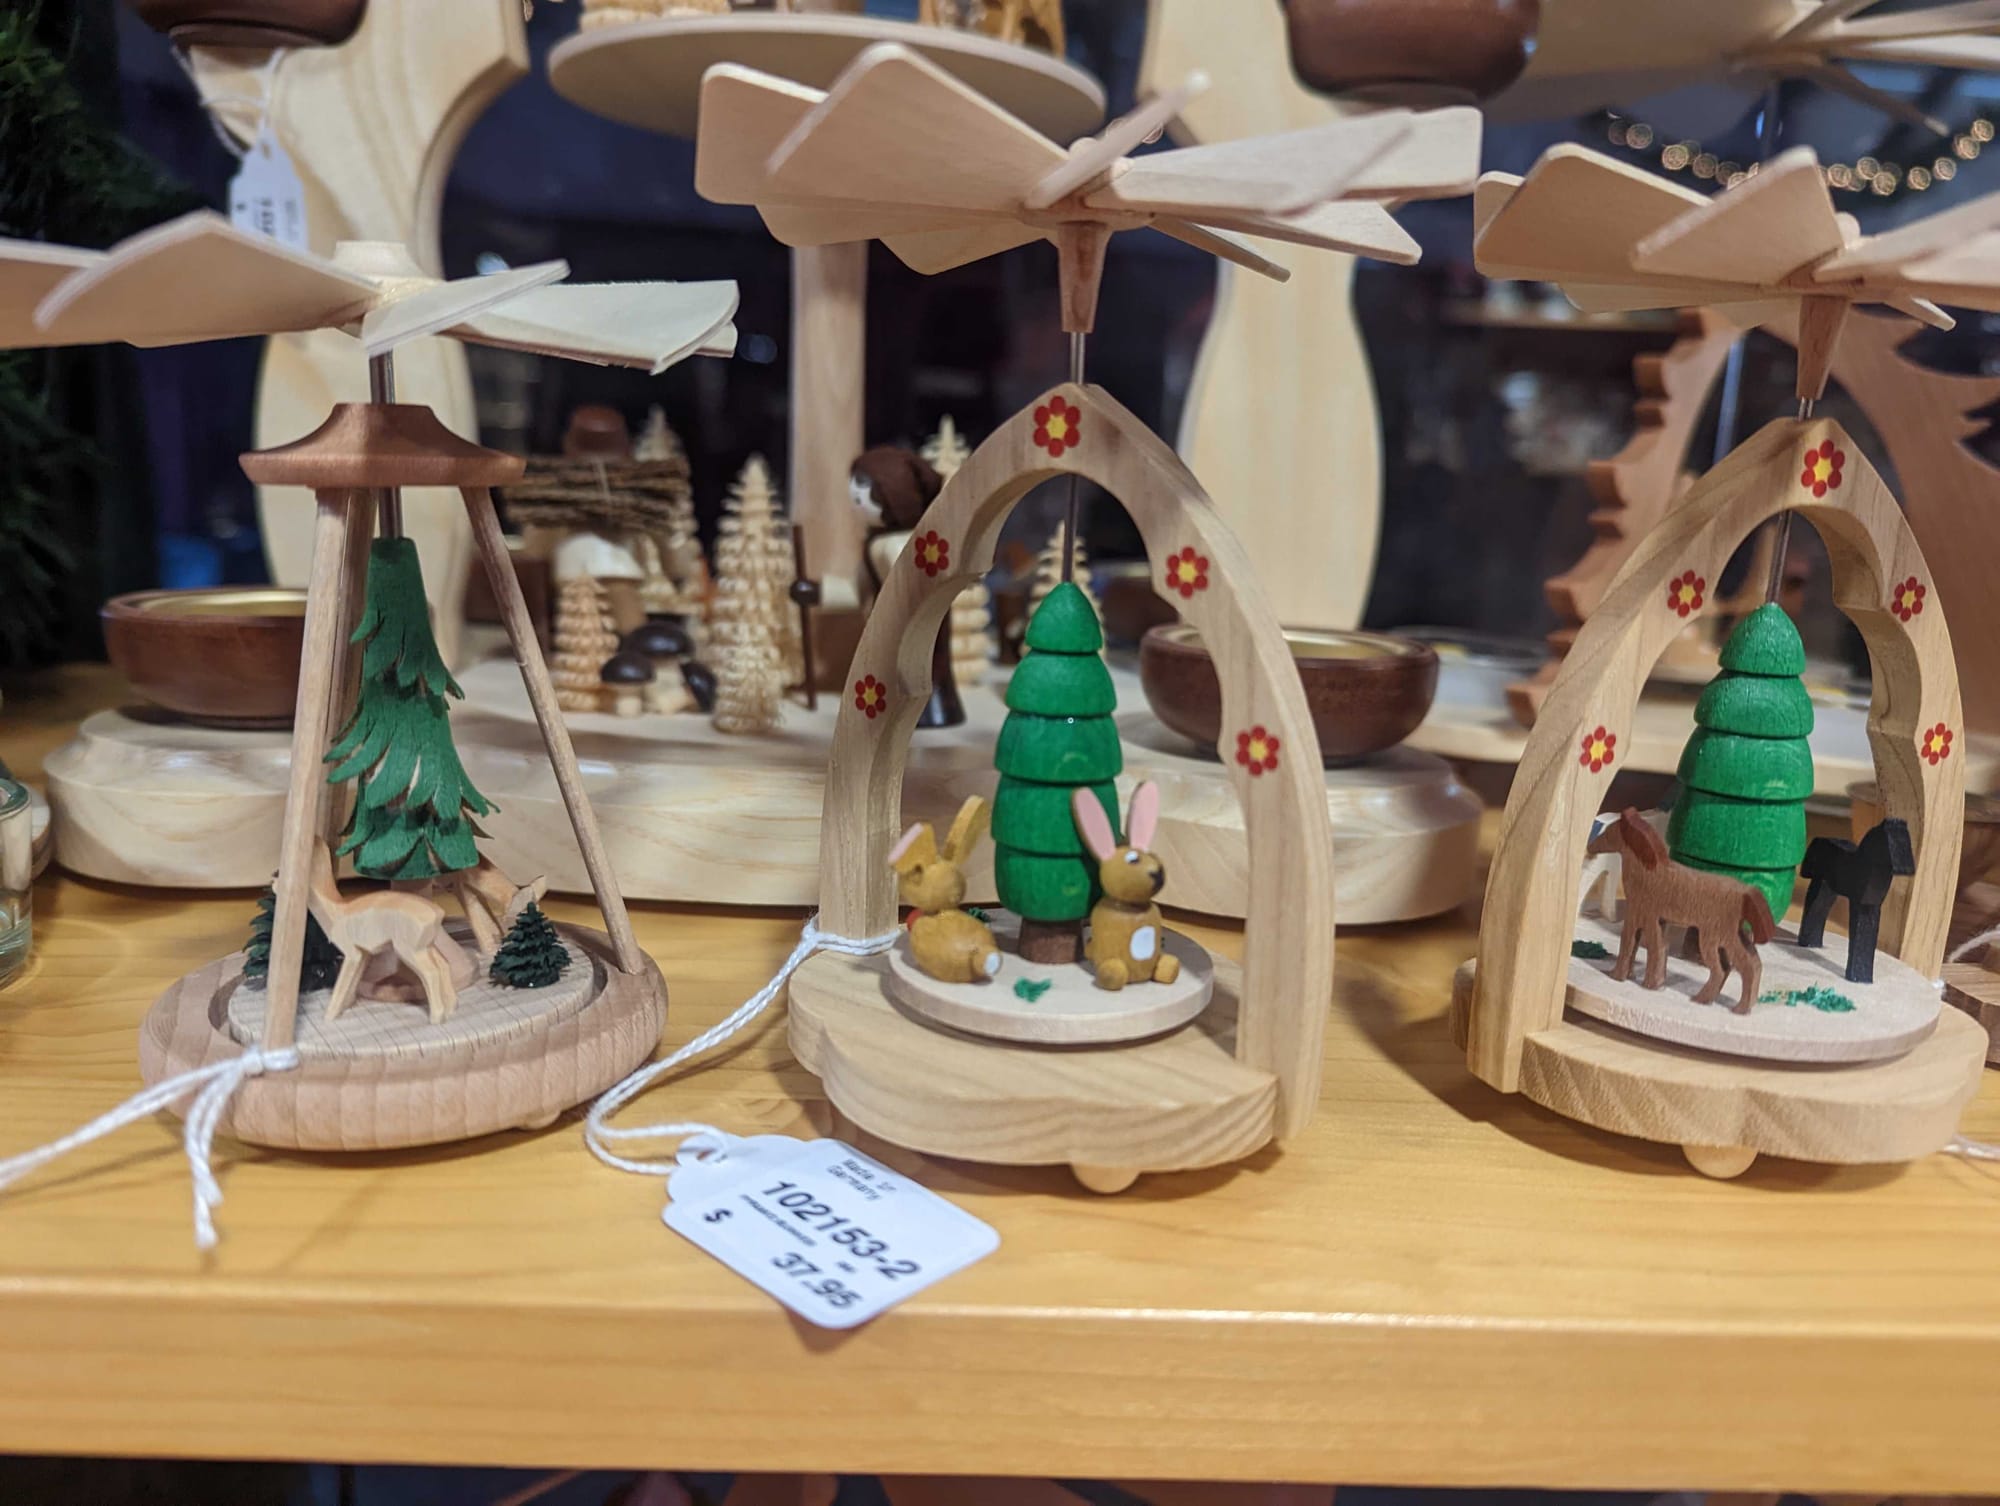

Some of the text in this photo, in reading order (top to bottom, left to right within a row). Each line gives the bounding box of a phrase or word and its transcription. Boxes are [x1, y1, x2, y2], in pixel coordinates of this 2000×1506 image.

[704, 1208, 733, 1223] $
[762, 1180, 920, 1280] 102153-2
[772, 1252, 863, 1308] 37.95
